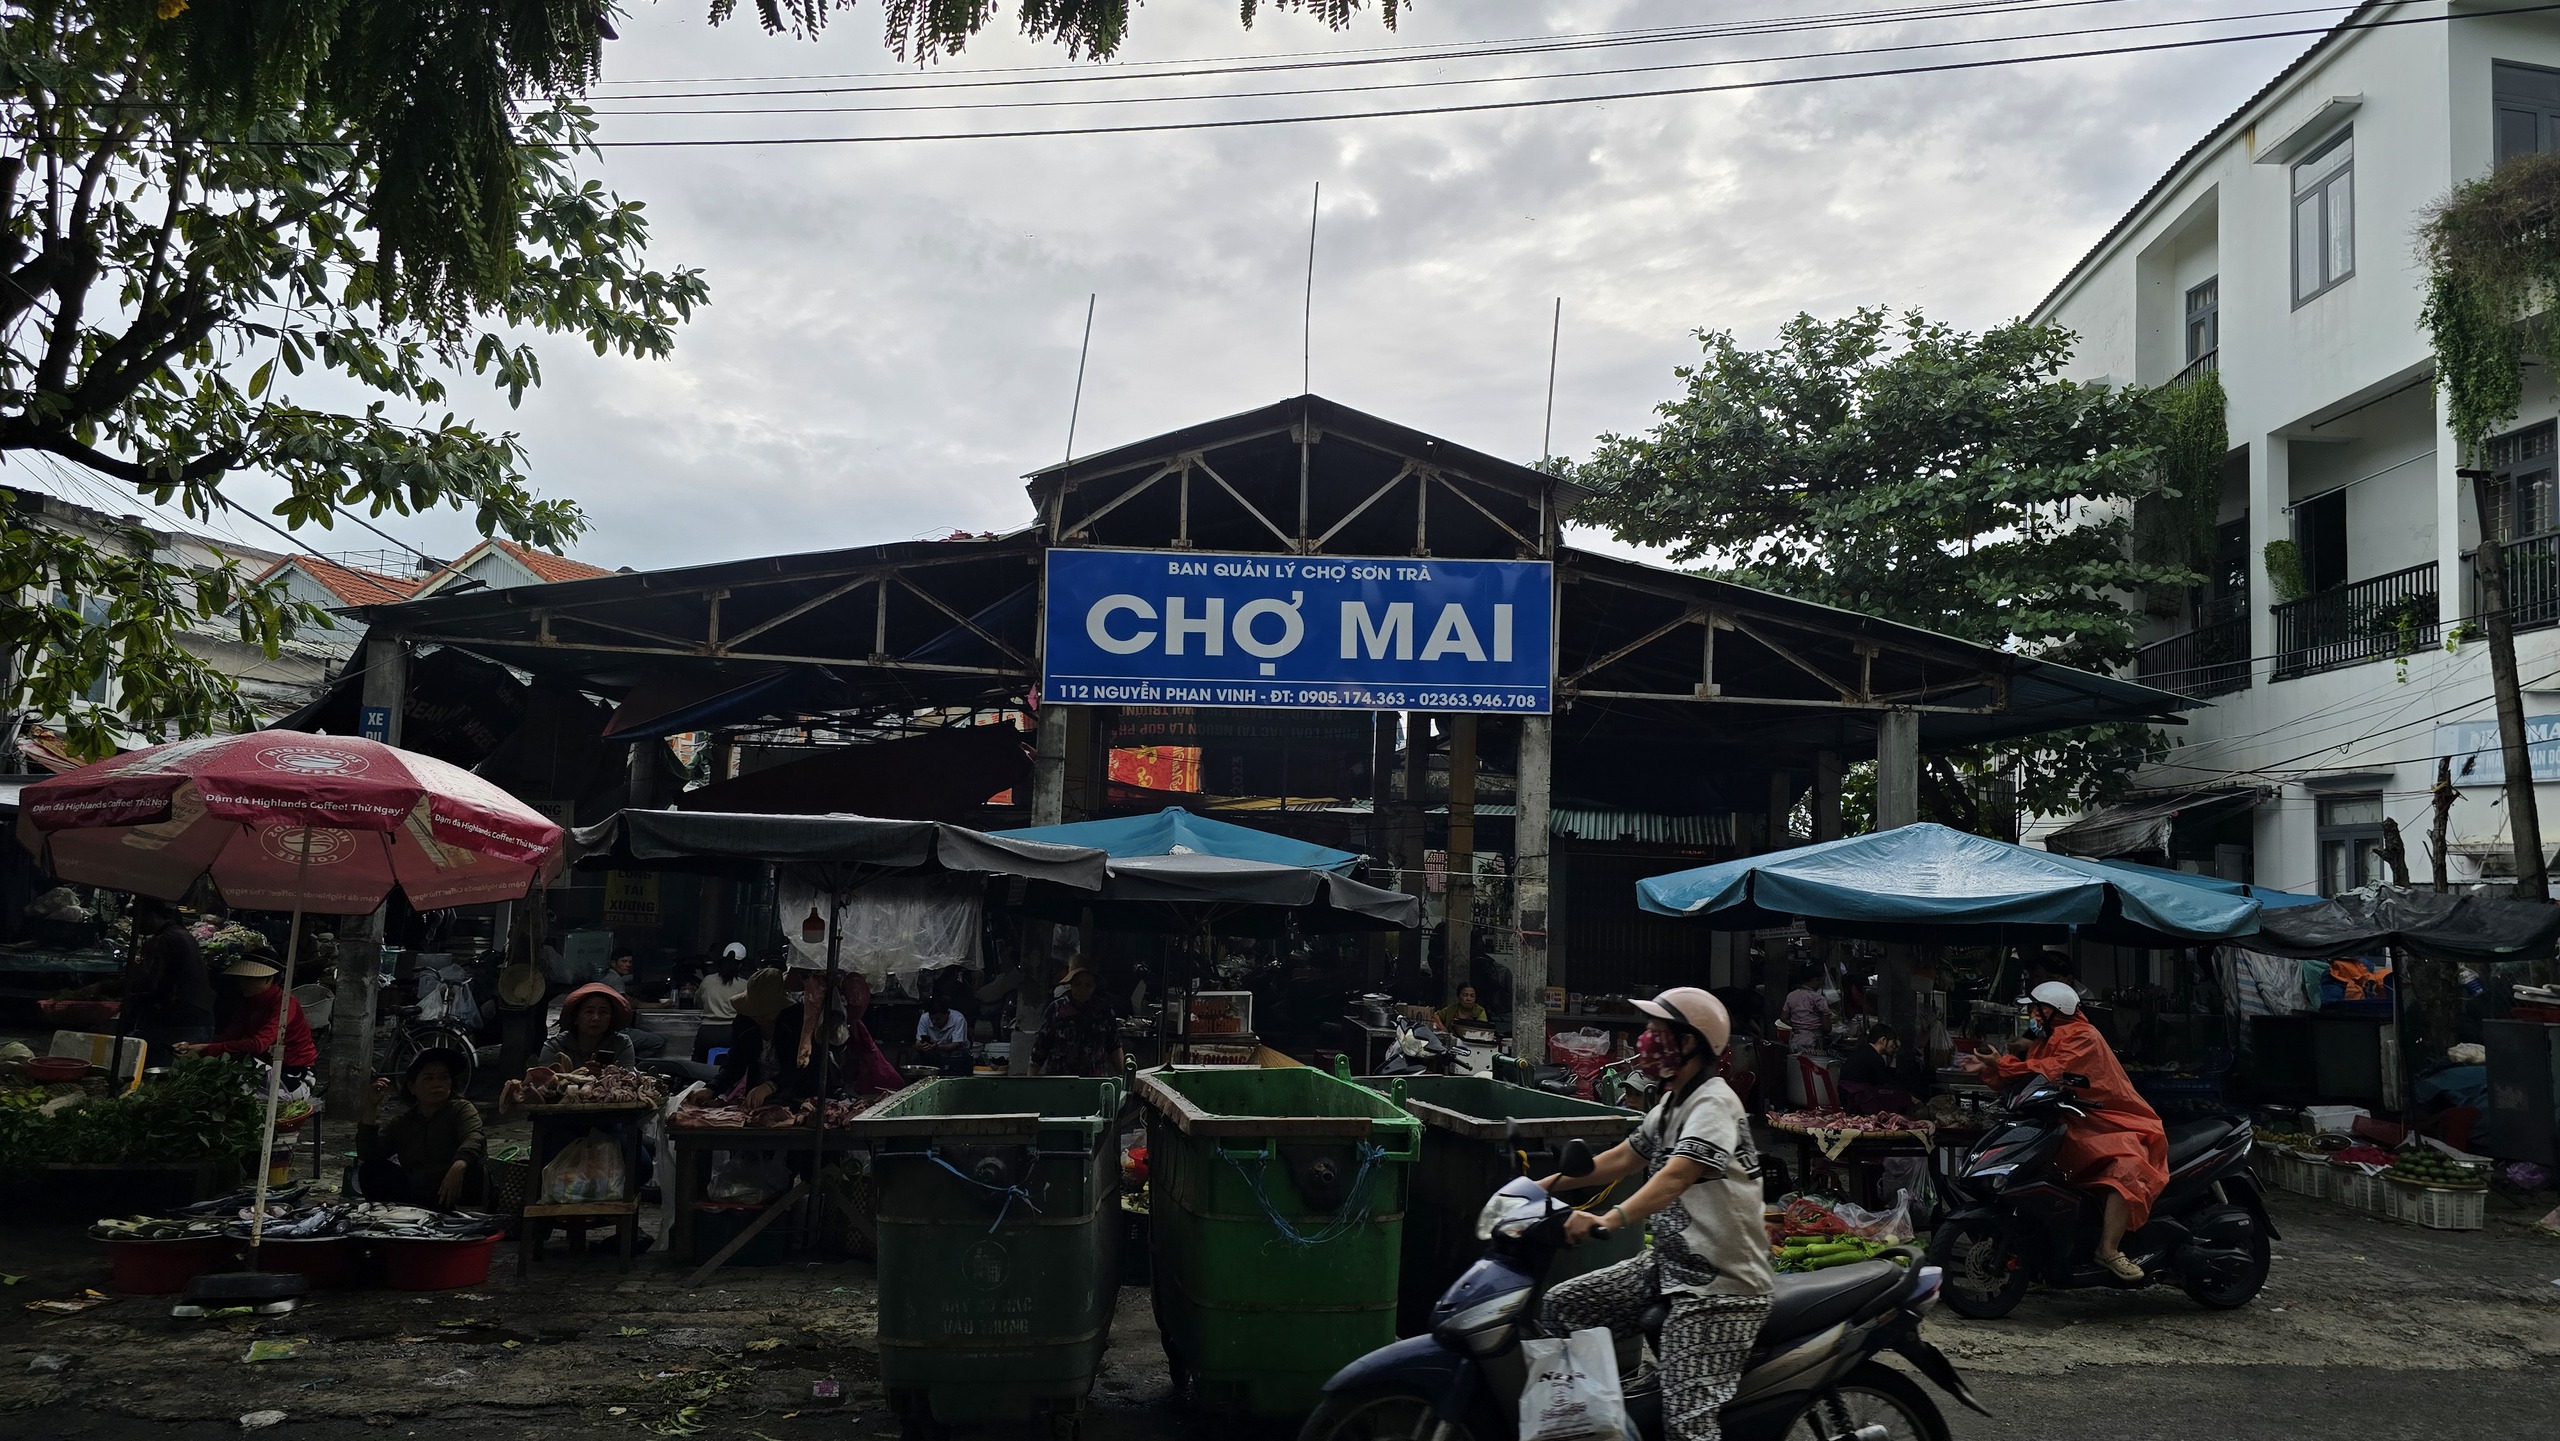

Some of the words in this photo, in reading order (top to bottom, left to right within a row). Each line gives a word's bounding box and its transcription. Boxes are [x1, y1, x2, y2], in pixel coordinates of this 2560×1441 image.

[1168, 562, 1207, 576] BAN
[1213, 560, 1269, 578] QUẢN
[1276, 562, 1296, 578] LÝ
[1301, 565, 1346, 582] CHỢ
[1352, 565, 1391, 580] SƠN
[1397, 564, 1432, 581] TRÀ
[1086, 591, 1304, 675] CHỢ
[1340, 601, 1513, 662] MAI
[1060, 685, 1088, 698] 112
[1094, 681, 1160, 700] NGUYỄN
[1166, 687, 1211, 701] PHAN
[1216, 689, 1256, 702] VINH
[1270, 689, 1294, 703] ĐT:
[1299, 690, 1405, 705] 0905.174.363
[1419, 692, 1536, 708] 02363.946.708
[368, 712, 384, 726] XE
[265, 747, 363, 764] HIGHLANDS
[206, 794, 233, 804] Đậm
[252, 797, 307, 810] Highlands
[310, 801, 348, 811] Coffee!
[351, 803, 372, 813] Thử
[374, 805, 404, 817] Ngay!
[461, 822, 491, 837] Highlands
[491, 831, 515, 844] Coffee!
[528, 842, 549, 853] Ngay!
